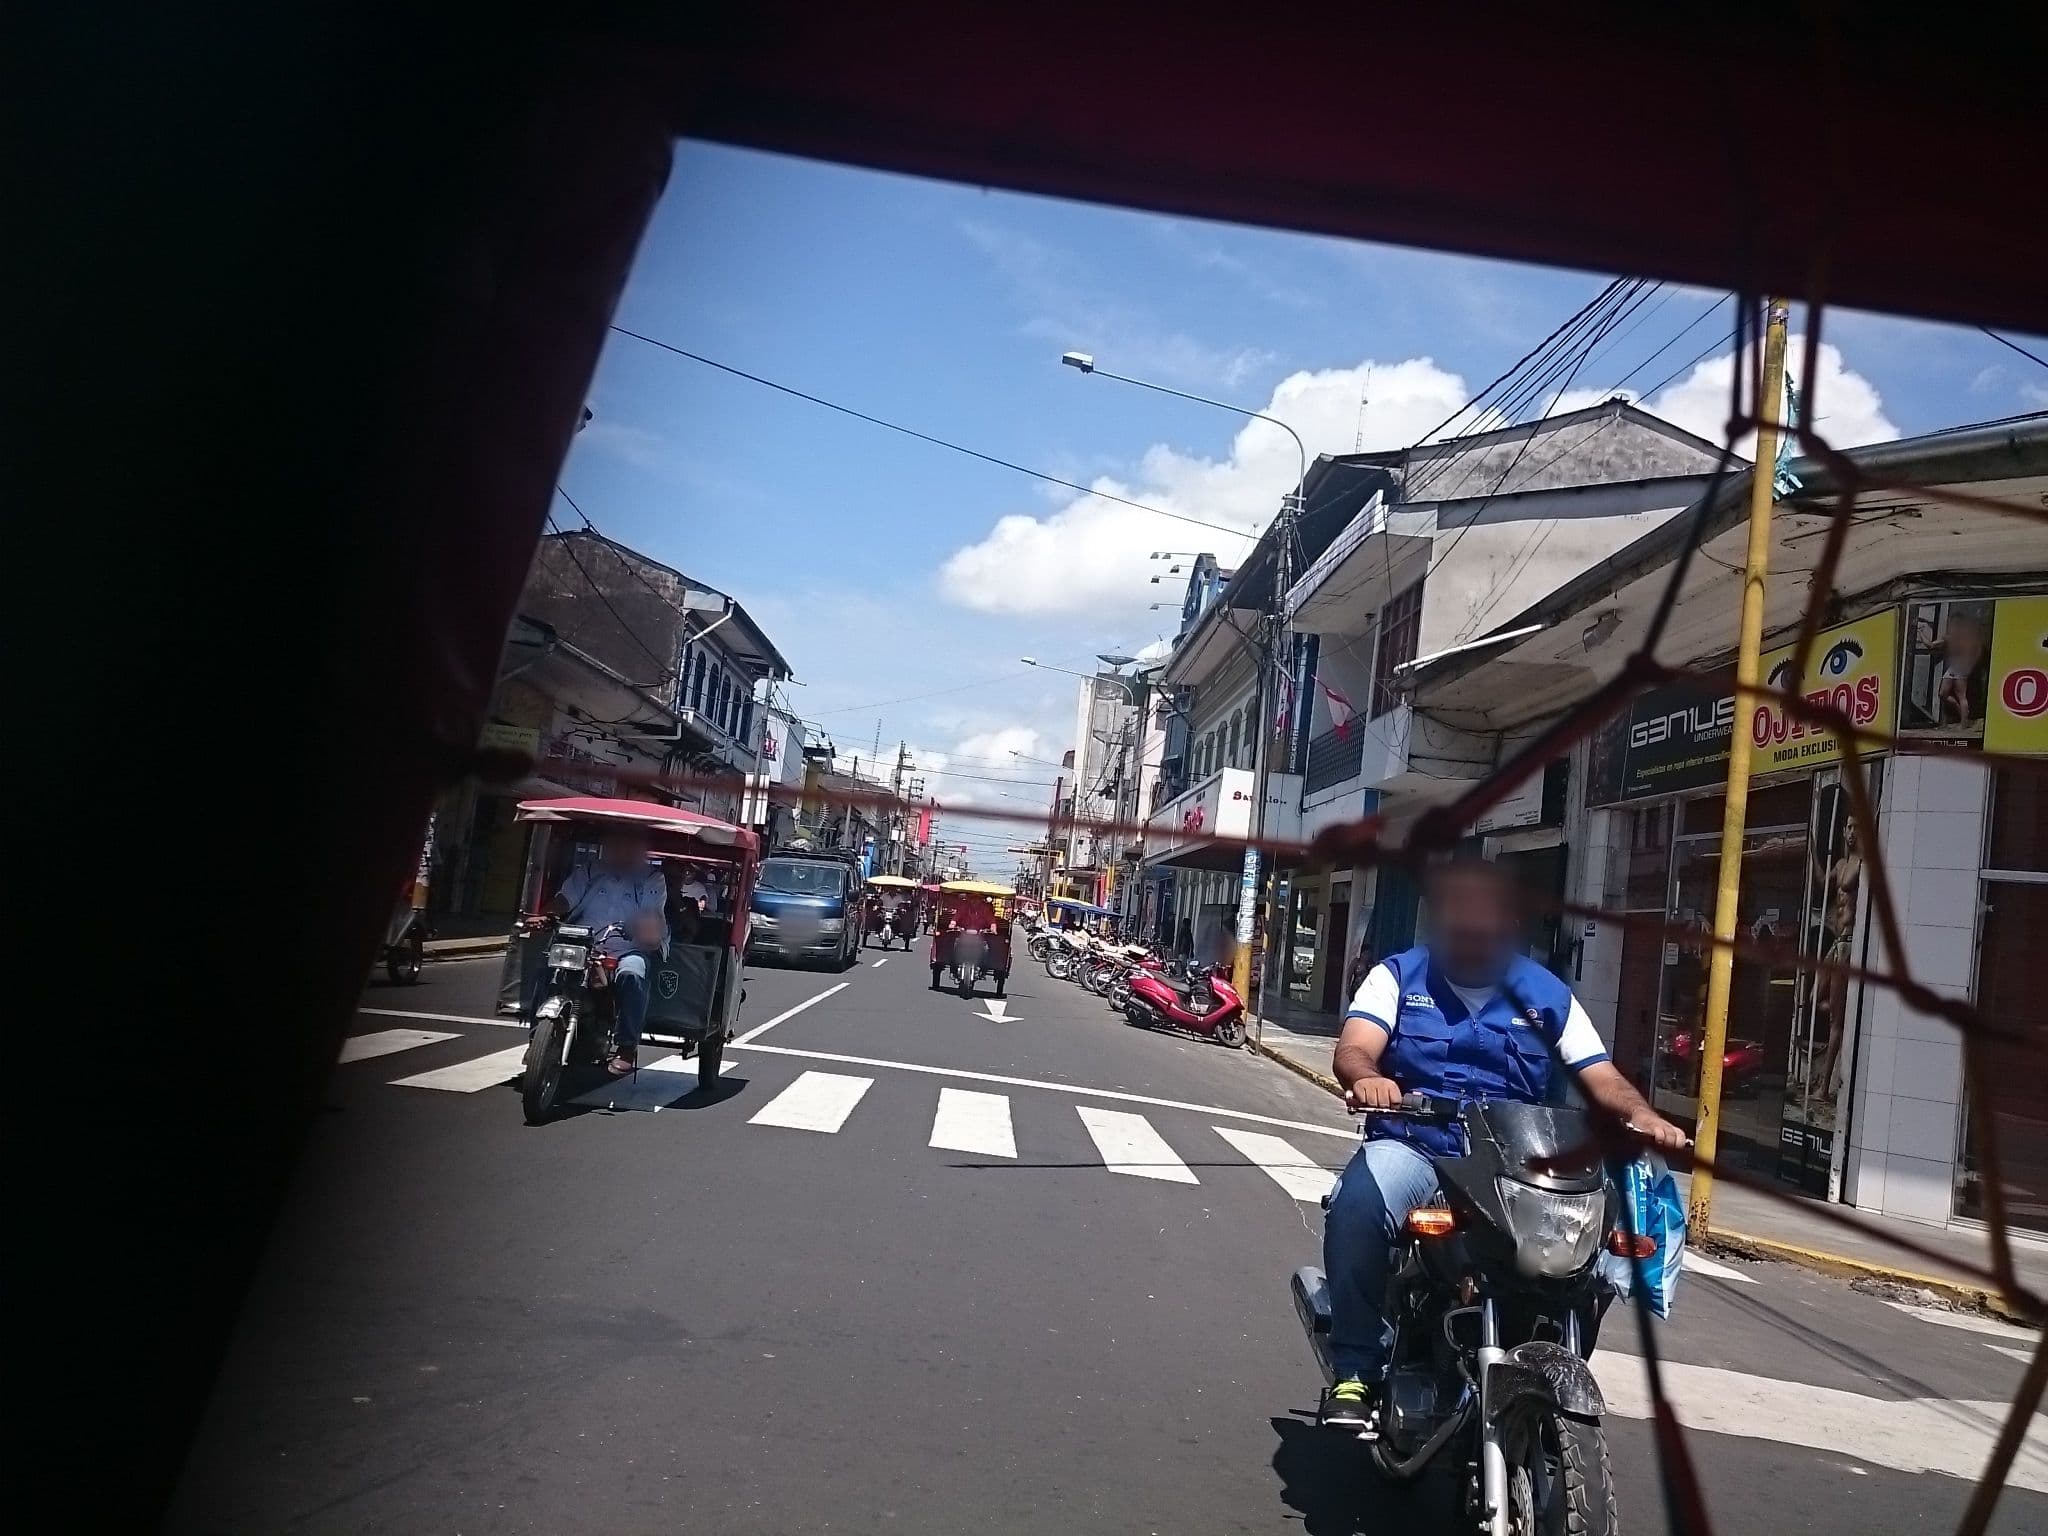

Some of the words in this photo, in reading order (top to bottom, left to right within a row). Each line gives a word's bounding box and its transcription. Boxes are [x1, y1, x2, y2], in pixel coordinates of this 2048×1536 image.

[1630, 695, 1736, 748] GENIUS
[1693, 726, 1735, 743] UNDERWEA
[1773, 746, 1799, 763] MODA
[1801, 739, 1841, 757] EXCLUSI
[1405, 994, 1435, 1005] SONY
